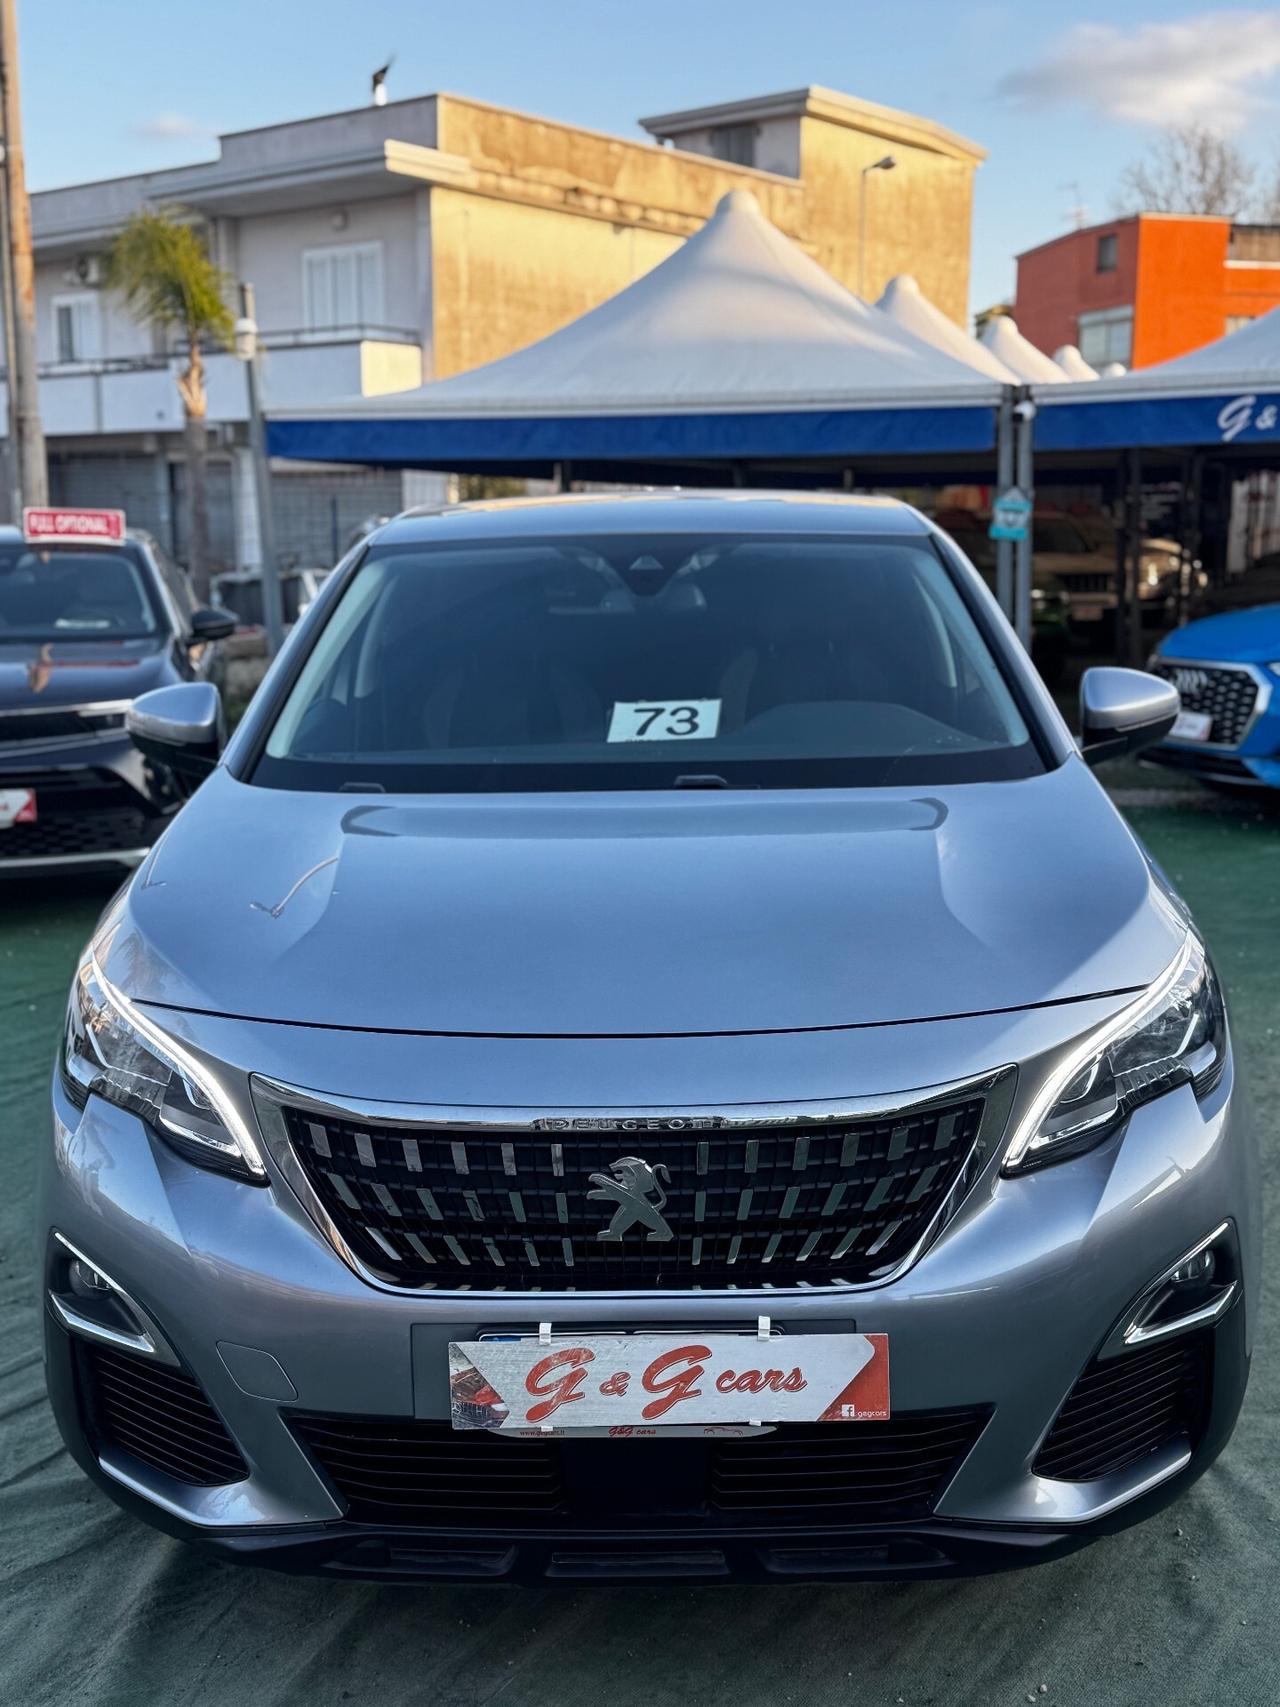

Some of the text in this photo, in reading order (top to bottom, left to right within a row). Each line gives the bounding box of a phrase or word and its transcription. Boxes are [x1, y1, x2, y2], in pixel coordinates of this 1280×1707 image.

[1255, 404, 1277, 430] &
[633, 706, 699, 736] 73
[525, 1344, 808, 1423] G & G cars
